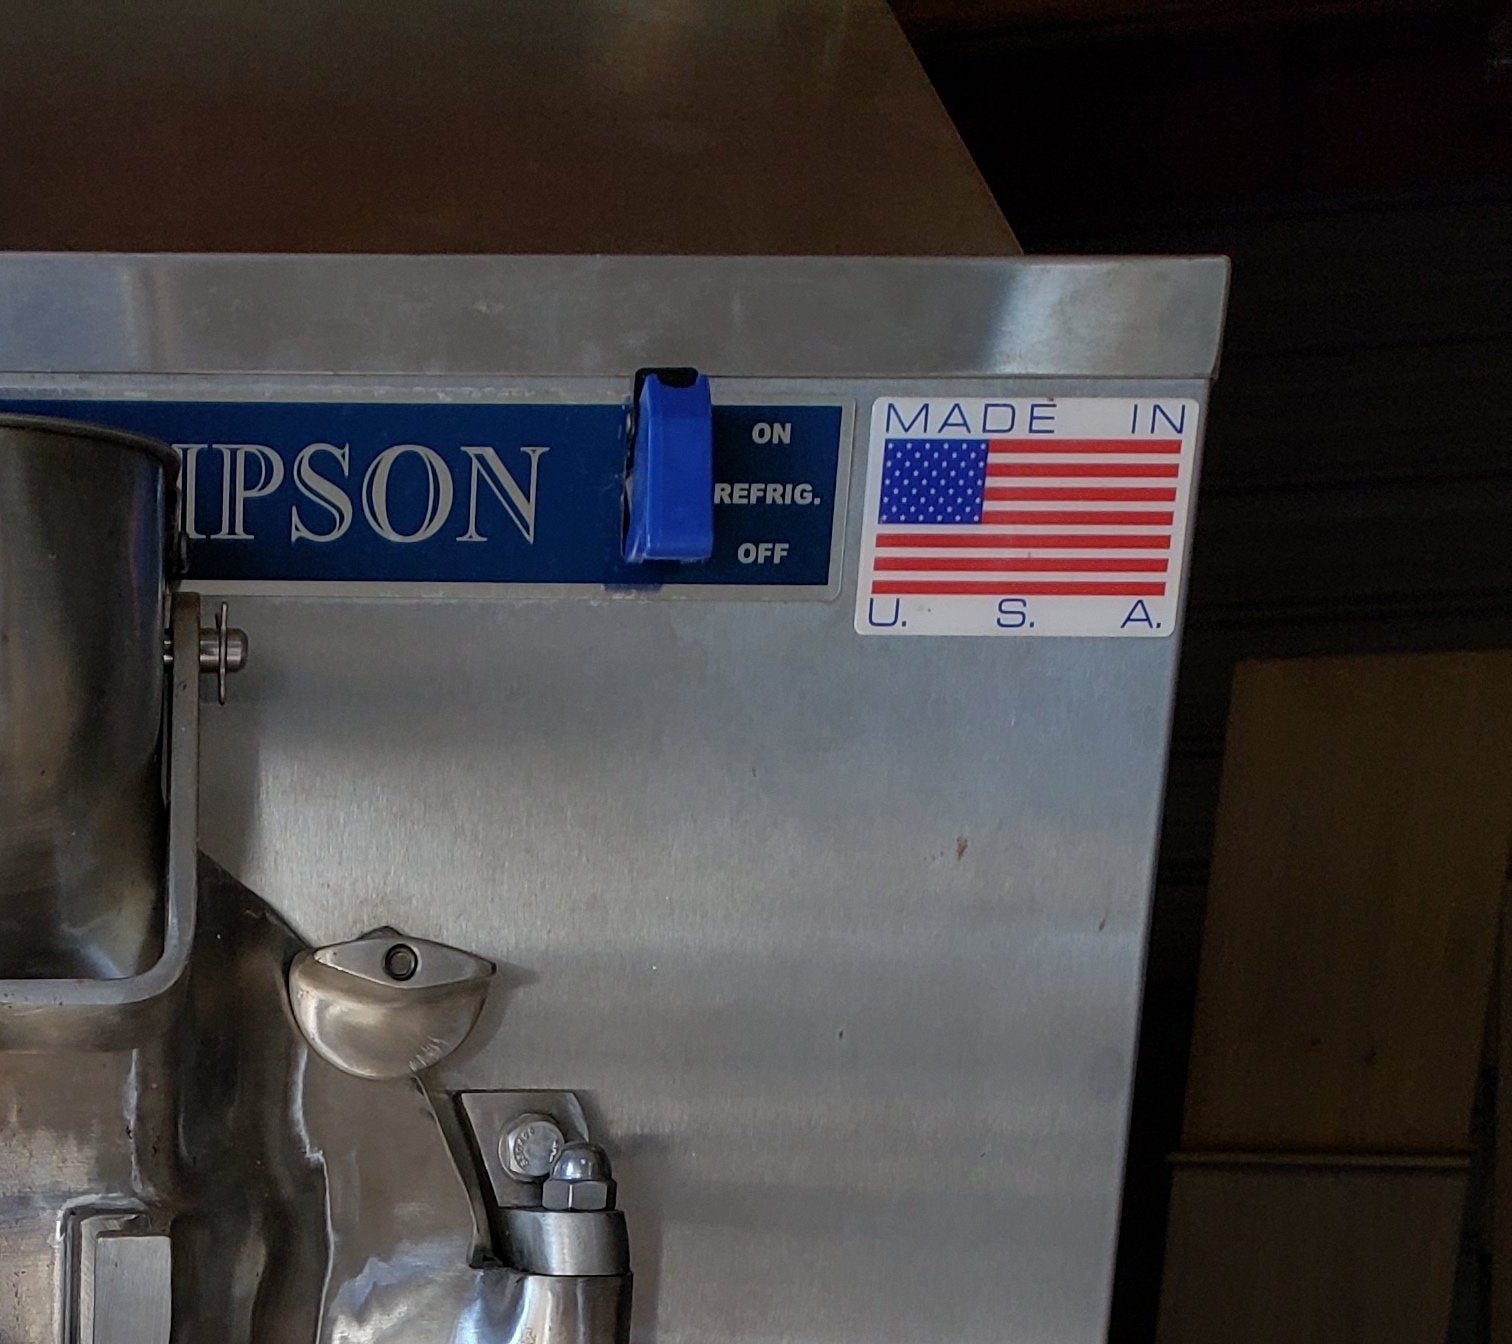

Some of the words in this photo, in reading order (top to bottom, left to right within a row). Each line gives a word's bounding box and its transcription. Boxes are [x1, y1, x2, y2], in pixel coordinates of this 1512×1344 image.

[886, 403, 1057, 433] MADE
[1132, 404, 1185, 434] IN
[752, 423, 791, 444] ON
[714, 483, 820, 505] REFRIG.
[738, 543, 789, 564] OFF
